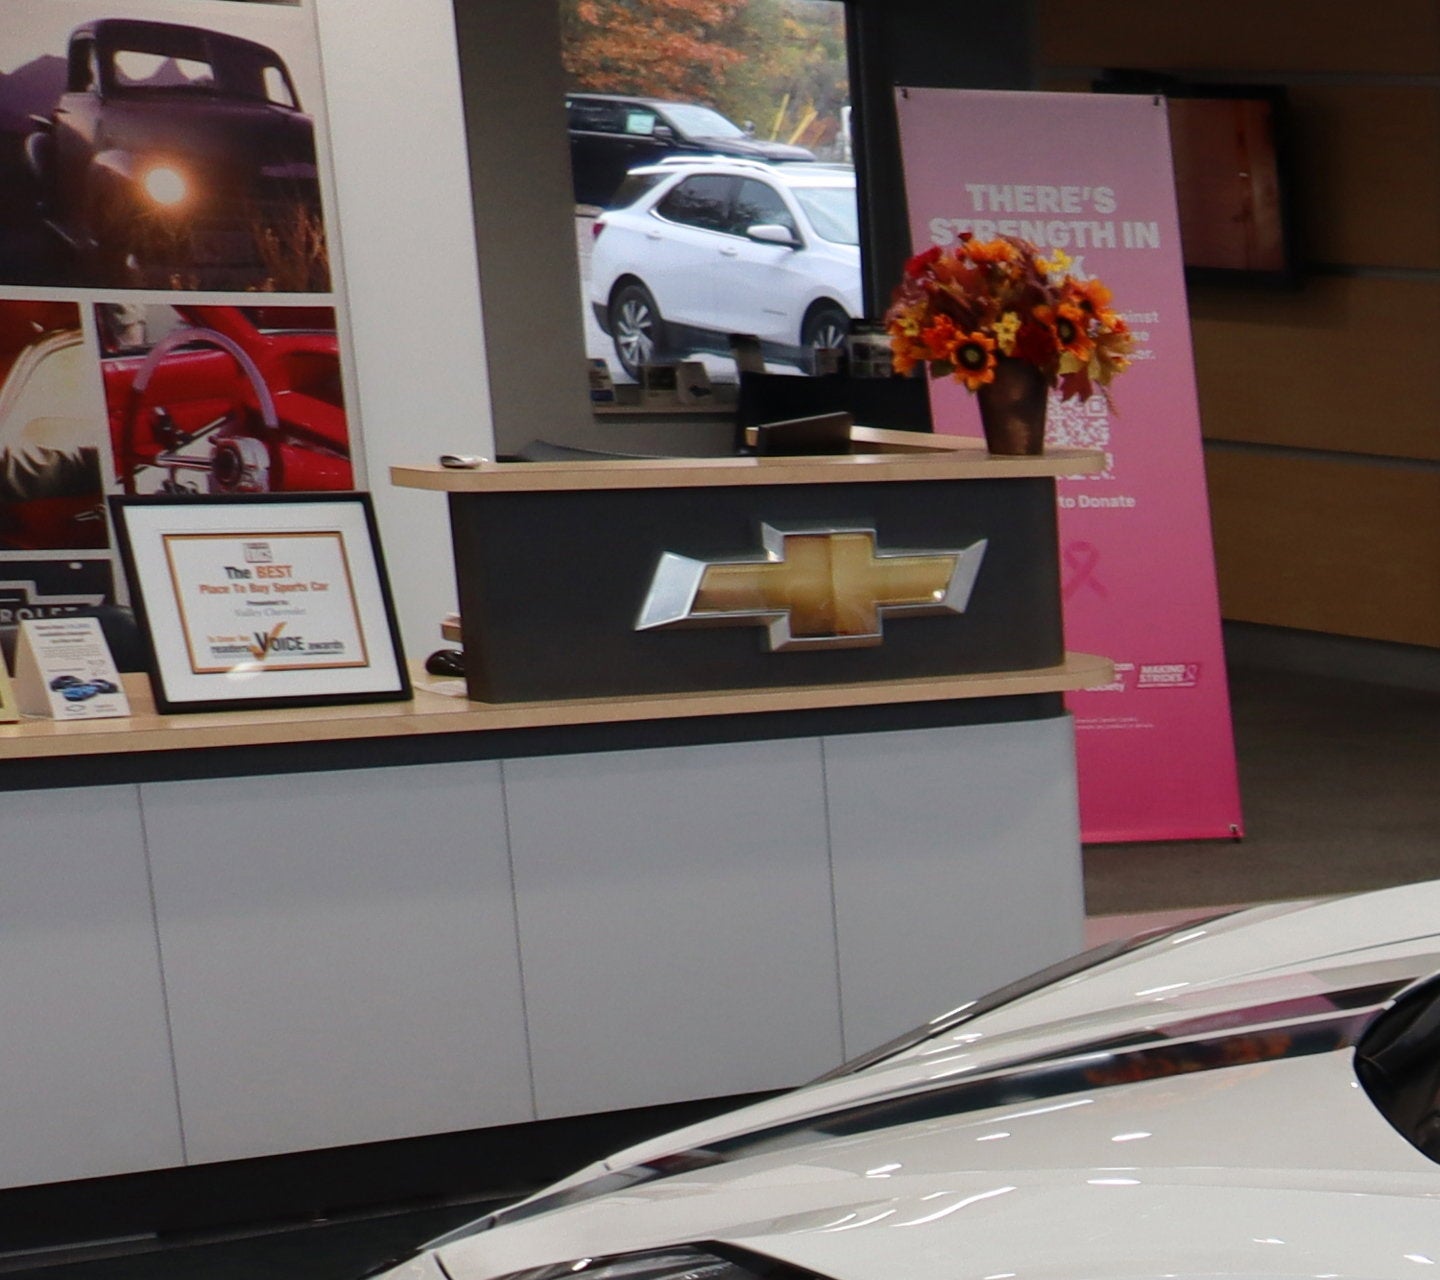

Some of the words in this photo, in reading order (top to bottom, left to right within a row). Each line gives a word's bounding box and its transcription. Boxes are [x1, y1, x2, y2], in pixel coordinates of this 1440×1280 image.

[965, 183, 1118, 215] THERE'S
[1122, 221, 1161, 249] IN
[1078, 495, 1136, 508] Donate
[224, 566, 251, 579] The
[255, 565, 292, 579] BEST
[199, 584, 230, 595] Place
[233, 583, 247, 594] To
[250, 583, 270, 595] Buy
[273, 582, 307, 595] Sports
